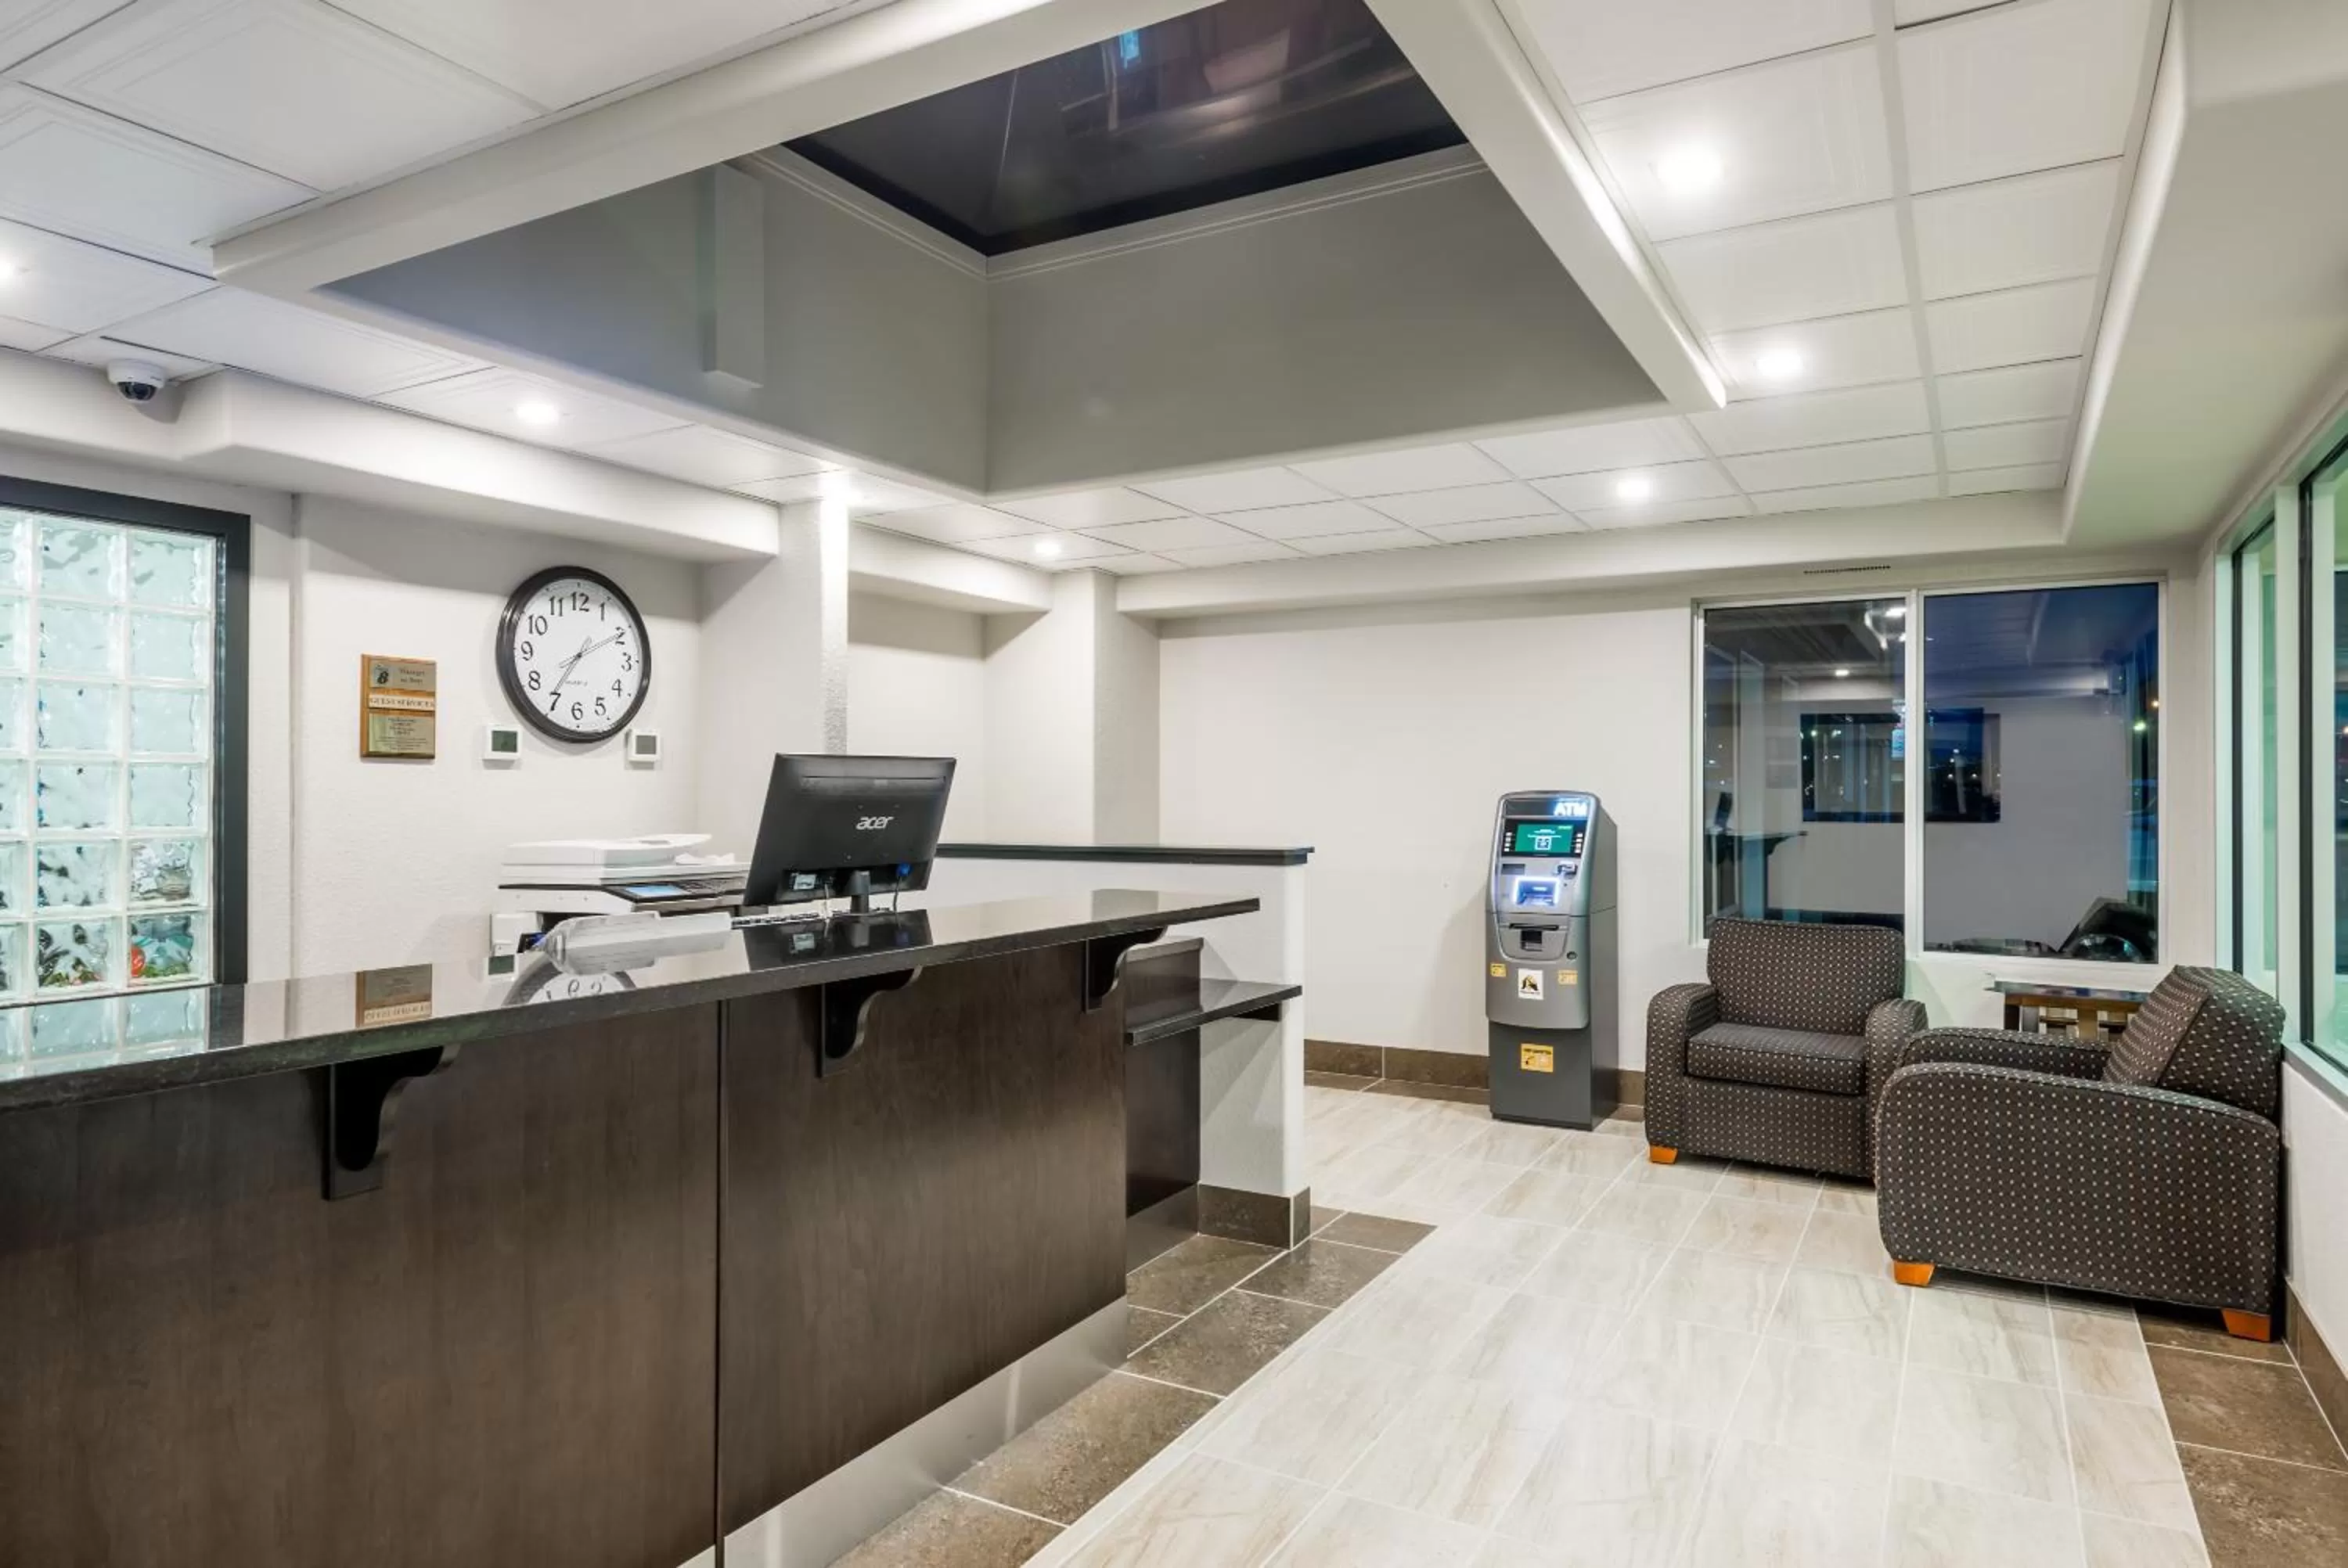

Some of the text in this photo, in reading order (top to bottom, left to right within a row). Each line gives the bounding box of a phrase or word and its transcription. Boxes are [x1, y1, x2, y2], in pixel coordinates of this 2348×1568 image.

[549, 595, 564, 617] 11
[570, 592, 589, 612] 12
[600, 602, 606, 621] 1
[528, 614, 548, 635] 10
[615, 627, 625, 645] 2
[520, 641, 533, 660] 9
[621, 653, 632, 671] 3
[528, 671, 541, 690] 8
[611, 679, 622, 698] 4
[549, 692, 561, 711] 7
[571, 702, 583, 720] 6
[595, 697, 606, 716] 5
[1554, 802, 1588, 816] ATM
[855, 816, 894, 830] acer
